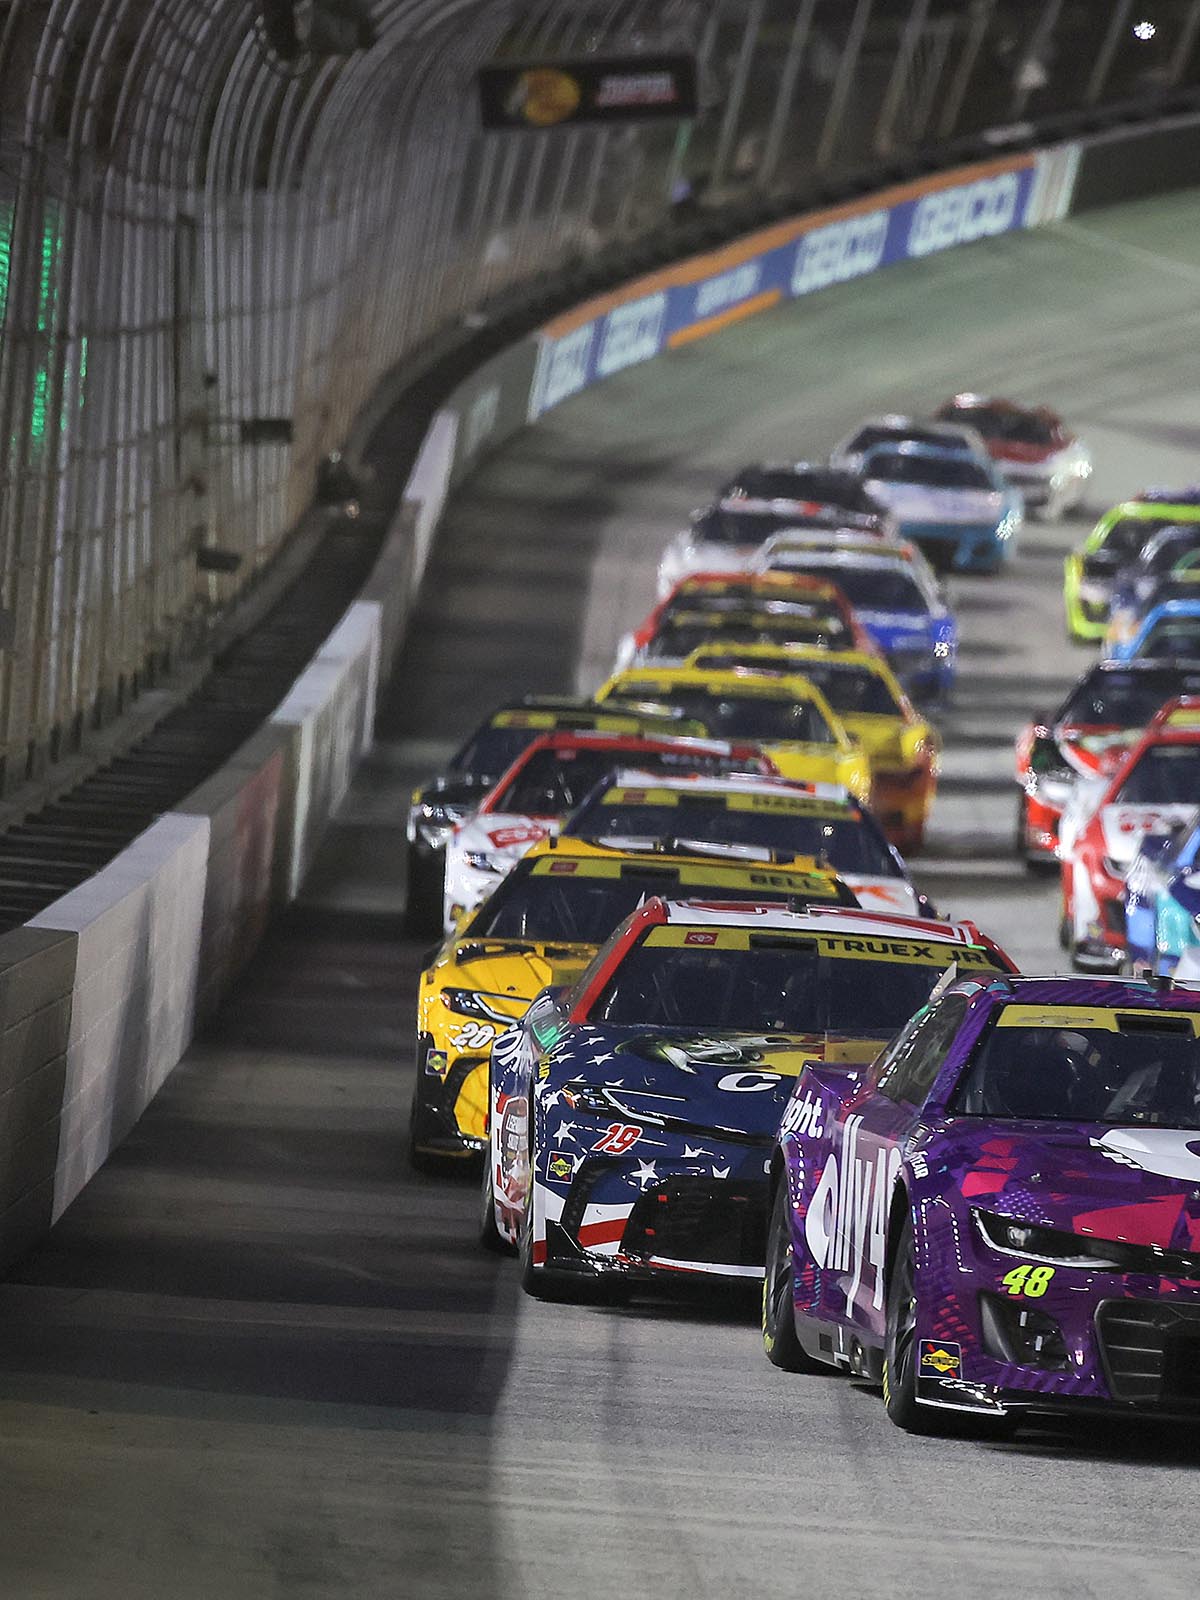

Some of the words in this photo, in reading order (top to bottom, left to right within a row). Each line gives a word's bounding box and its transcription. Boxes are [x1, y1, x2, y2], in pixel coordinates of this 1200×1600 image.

[907, 171, 1018, 258] GEICO
[751, 874, 818, 890] BELL
[819, 938, 935, 959] TRUEX
[455, 1021, 496, 1049] 20
[780, 1085, 823, 1139] ight.
[590, 1122, 643, 1155] 19
[1002, 1265, 1056, 1298] 48
[922, 1353, 960, 1368] SUNOCO
